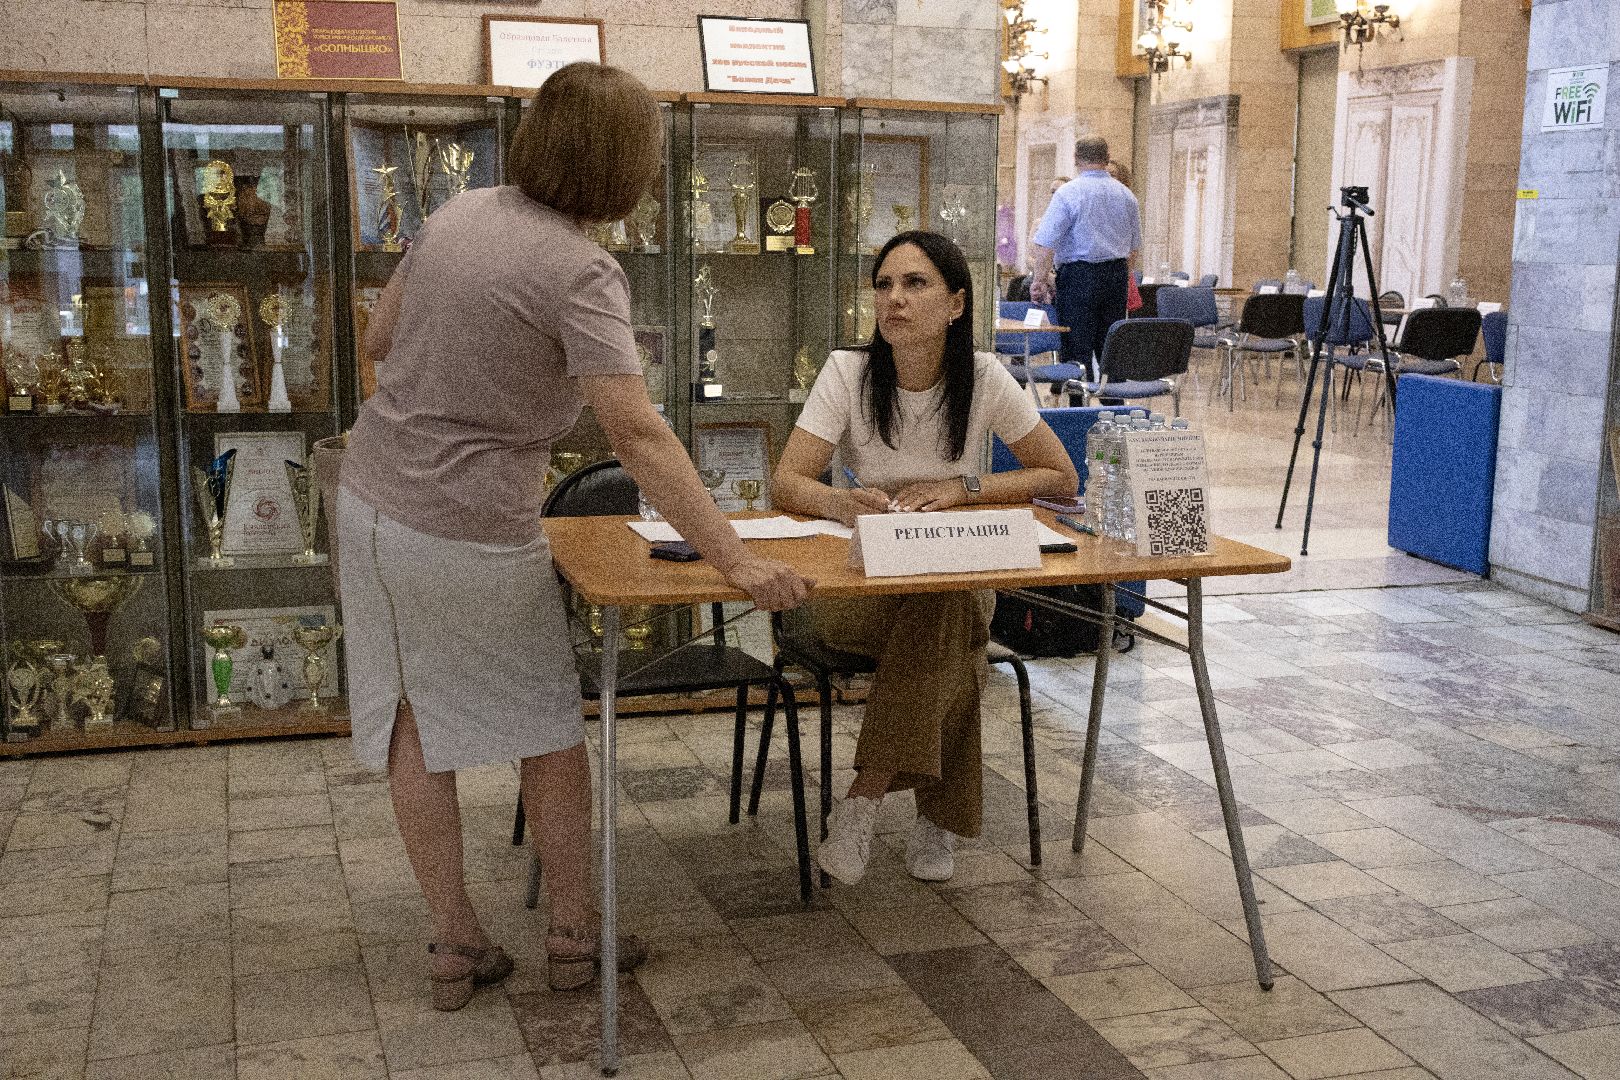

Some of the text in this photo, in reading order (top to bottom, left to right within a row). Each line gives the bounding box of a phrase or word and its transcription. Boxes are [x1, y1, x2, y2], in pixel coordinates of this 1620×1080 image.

[314, 44, 394, 52] «СОЛНЫШКО»
[1555, 85, 1583, 99] FREE
[1554, 99, 1592, 124] WiFi
[894, 524, 1010, 540] РЕГИСТРАЦИЯ
